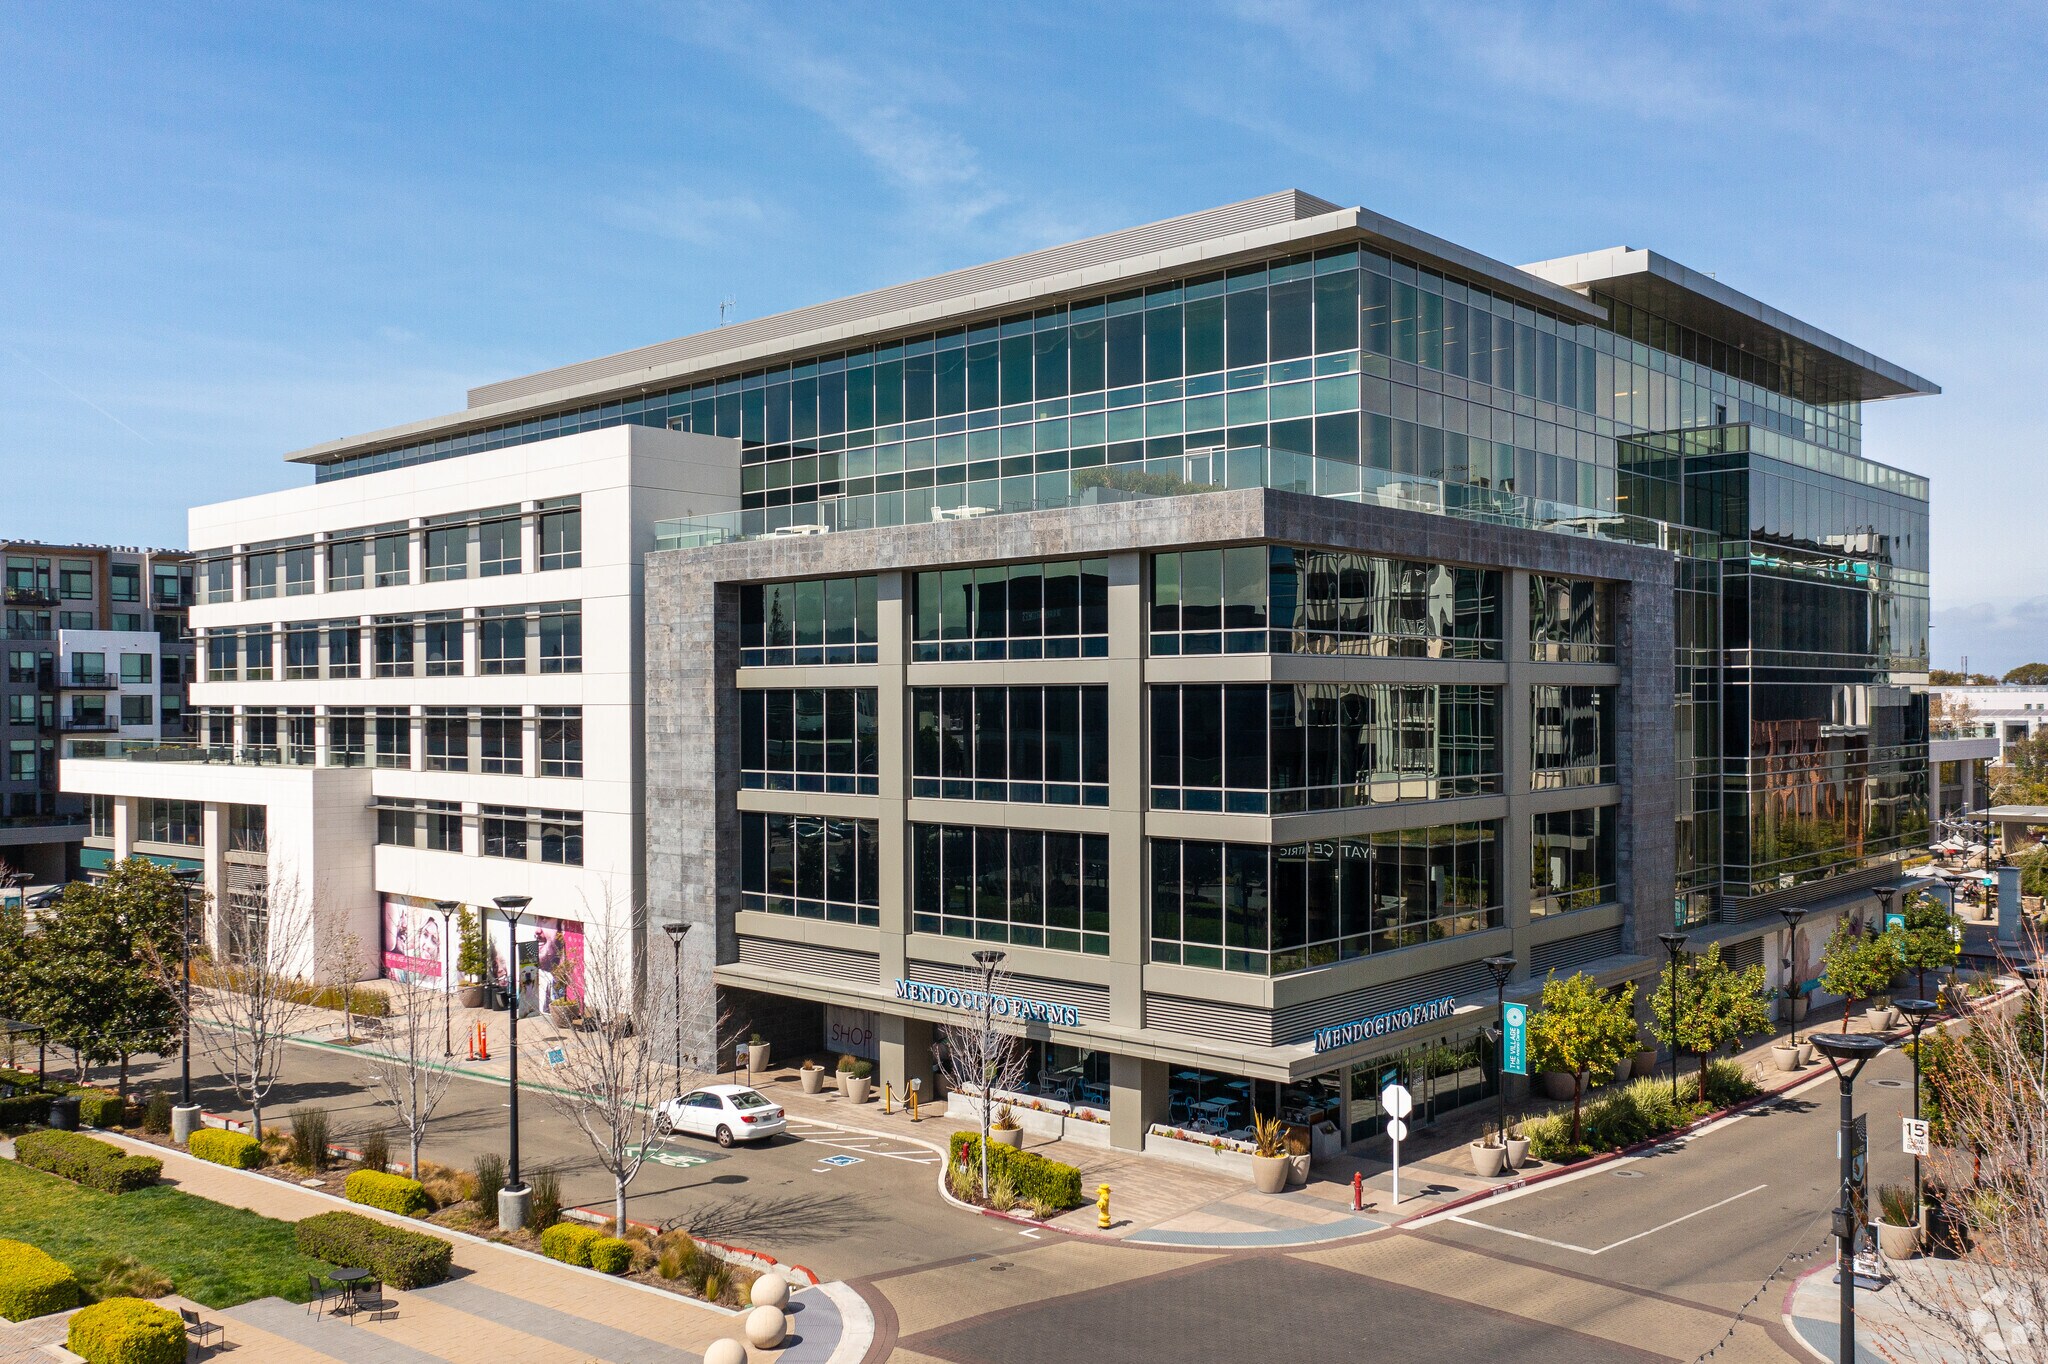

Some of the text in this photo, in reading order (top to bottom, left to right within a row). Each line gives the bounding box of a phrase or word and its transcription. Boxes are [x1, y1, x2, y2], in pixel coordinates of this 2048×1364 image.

[1012, 997, 1079, 1026] FARMS
[1314, 995, 1456, 1053] MENDOCINO FARMS
[832, 1023, 873, 1047] SHOP
[1906, 1122, 1924, 1137] 15
